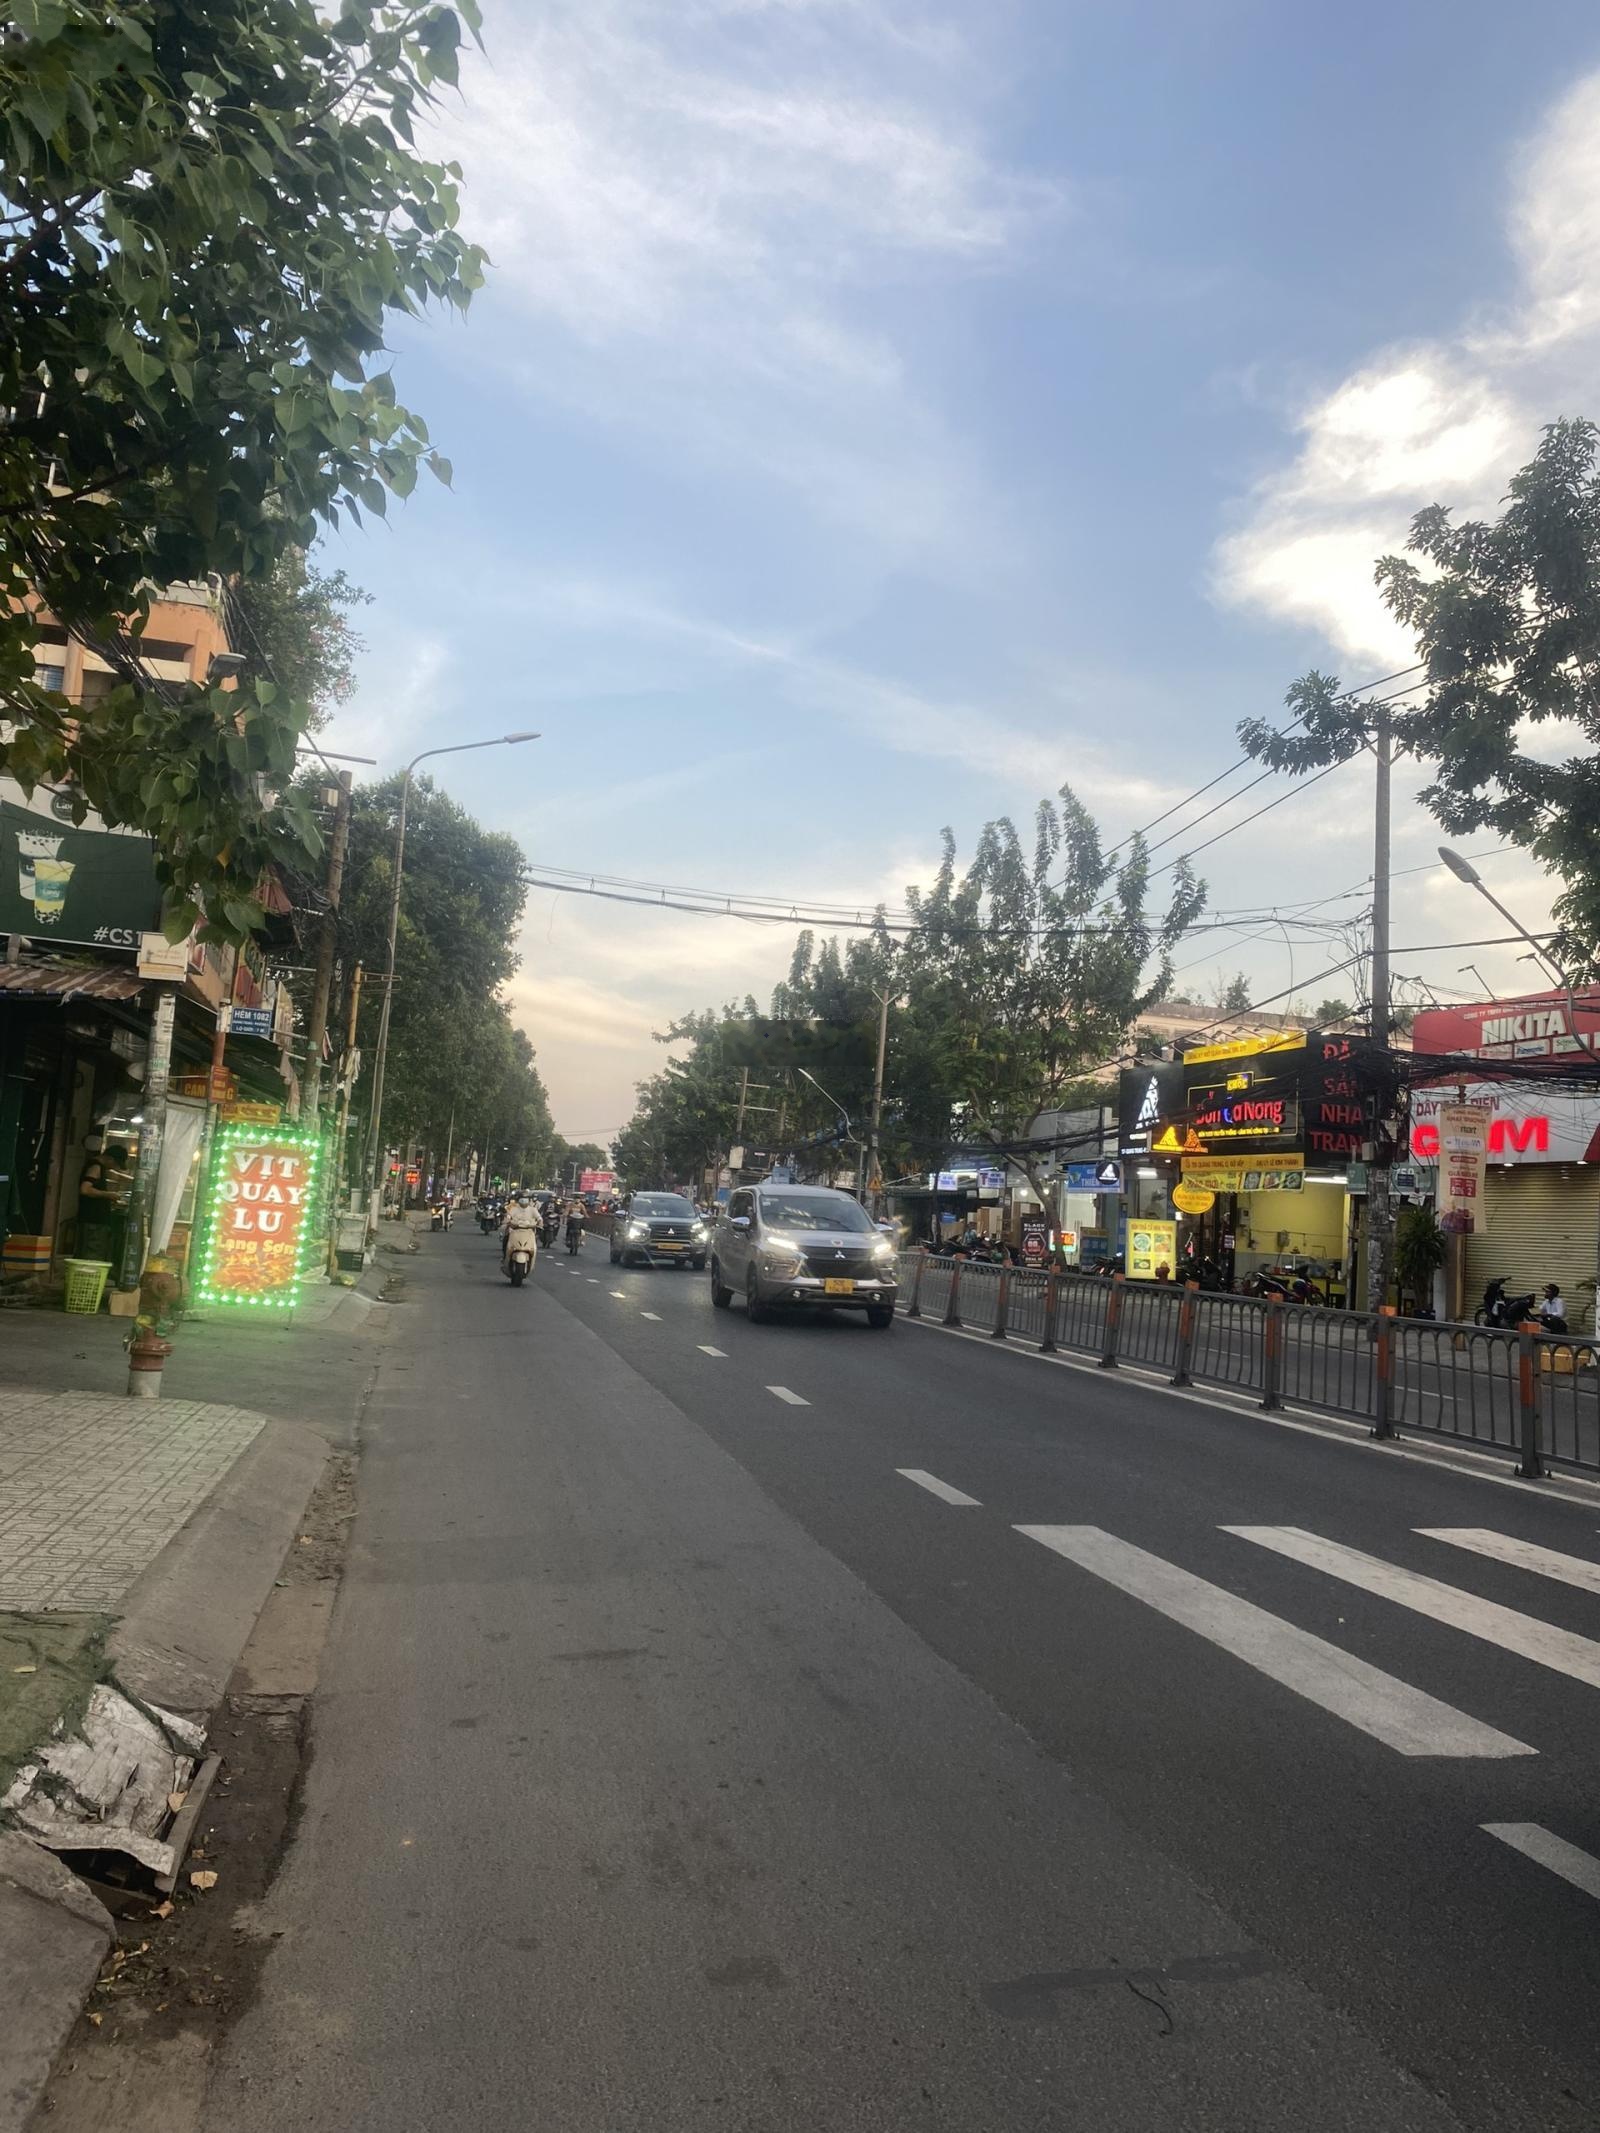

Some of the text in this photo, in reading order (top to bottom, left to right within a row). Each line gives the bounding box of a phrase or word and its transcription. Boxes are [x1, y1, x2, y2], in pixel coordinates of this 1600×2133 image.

[1482, 1010, 1566, 1045] NIKITA
[1321, 1103, 1363, 1123] NHA
[1416, 1099, 1439, 1117] DÂY
[1310, 1131, 1364, 1153] TRAN
[233, 1151, 300, 1180] VỊT
[222, 1181, 306, 1205] QUAY
[233, 1207, 285, 1232] LU
[215, 1235, 295, 1256] Lạng Sơn
